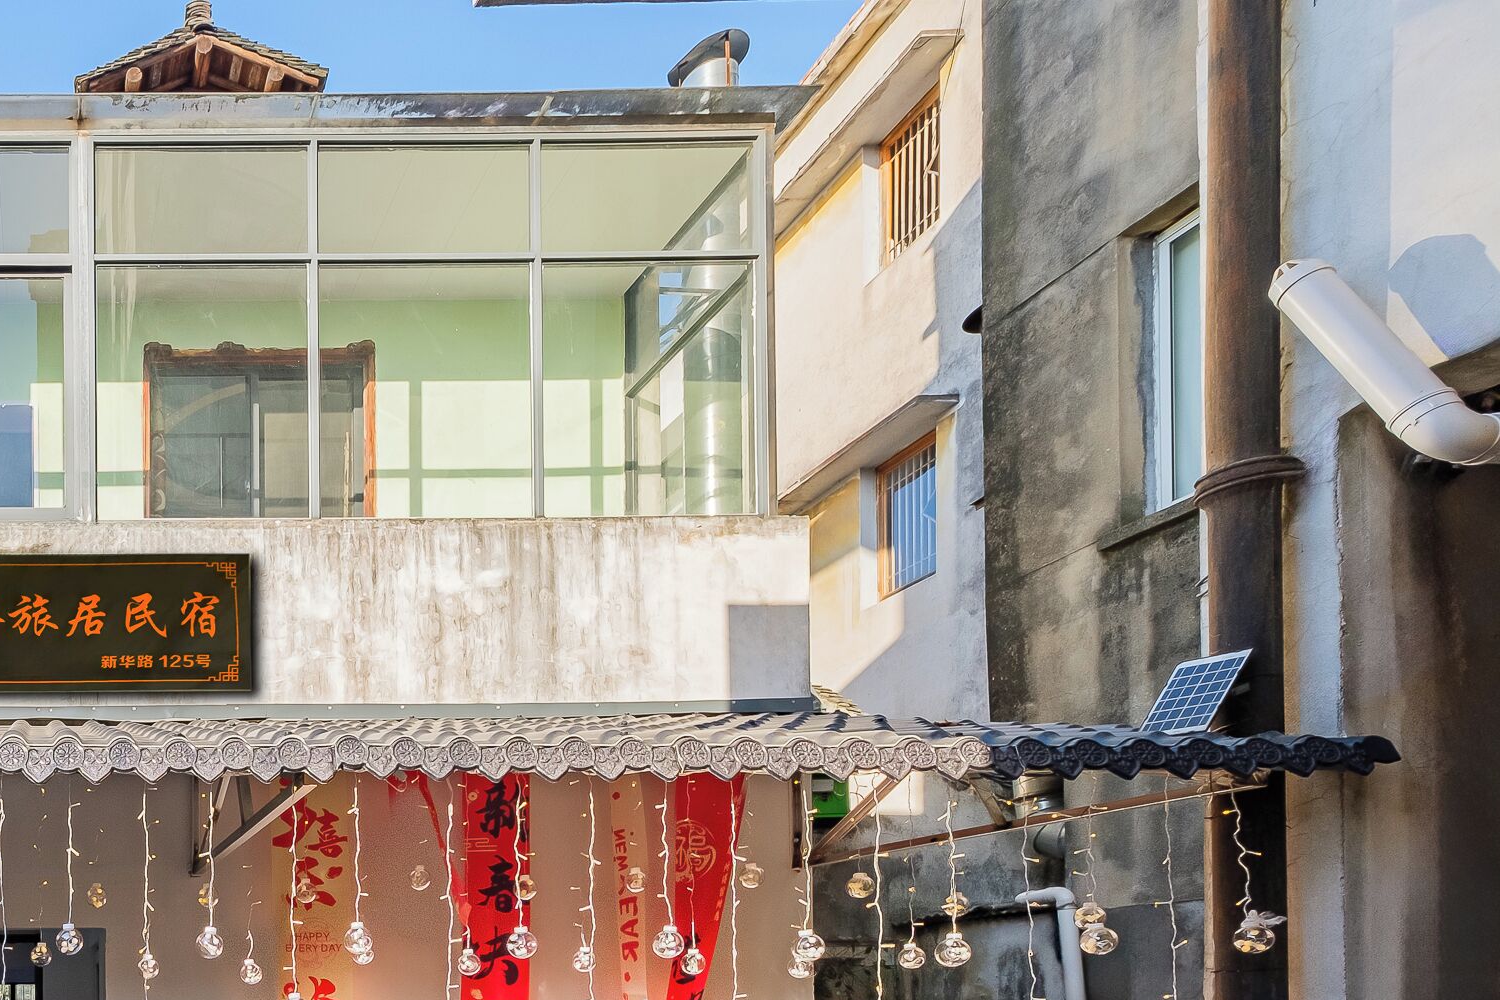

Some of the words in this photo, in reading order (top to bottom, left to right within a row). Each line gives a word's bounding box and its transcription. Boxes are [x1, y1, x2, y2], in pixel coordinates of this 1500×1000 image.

[101, 655, 154, 669] 新华路
[295, 932, 330, 941] HAPPY
